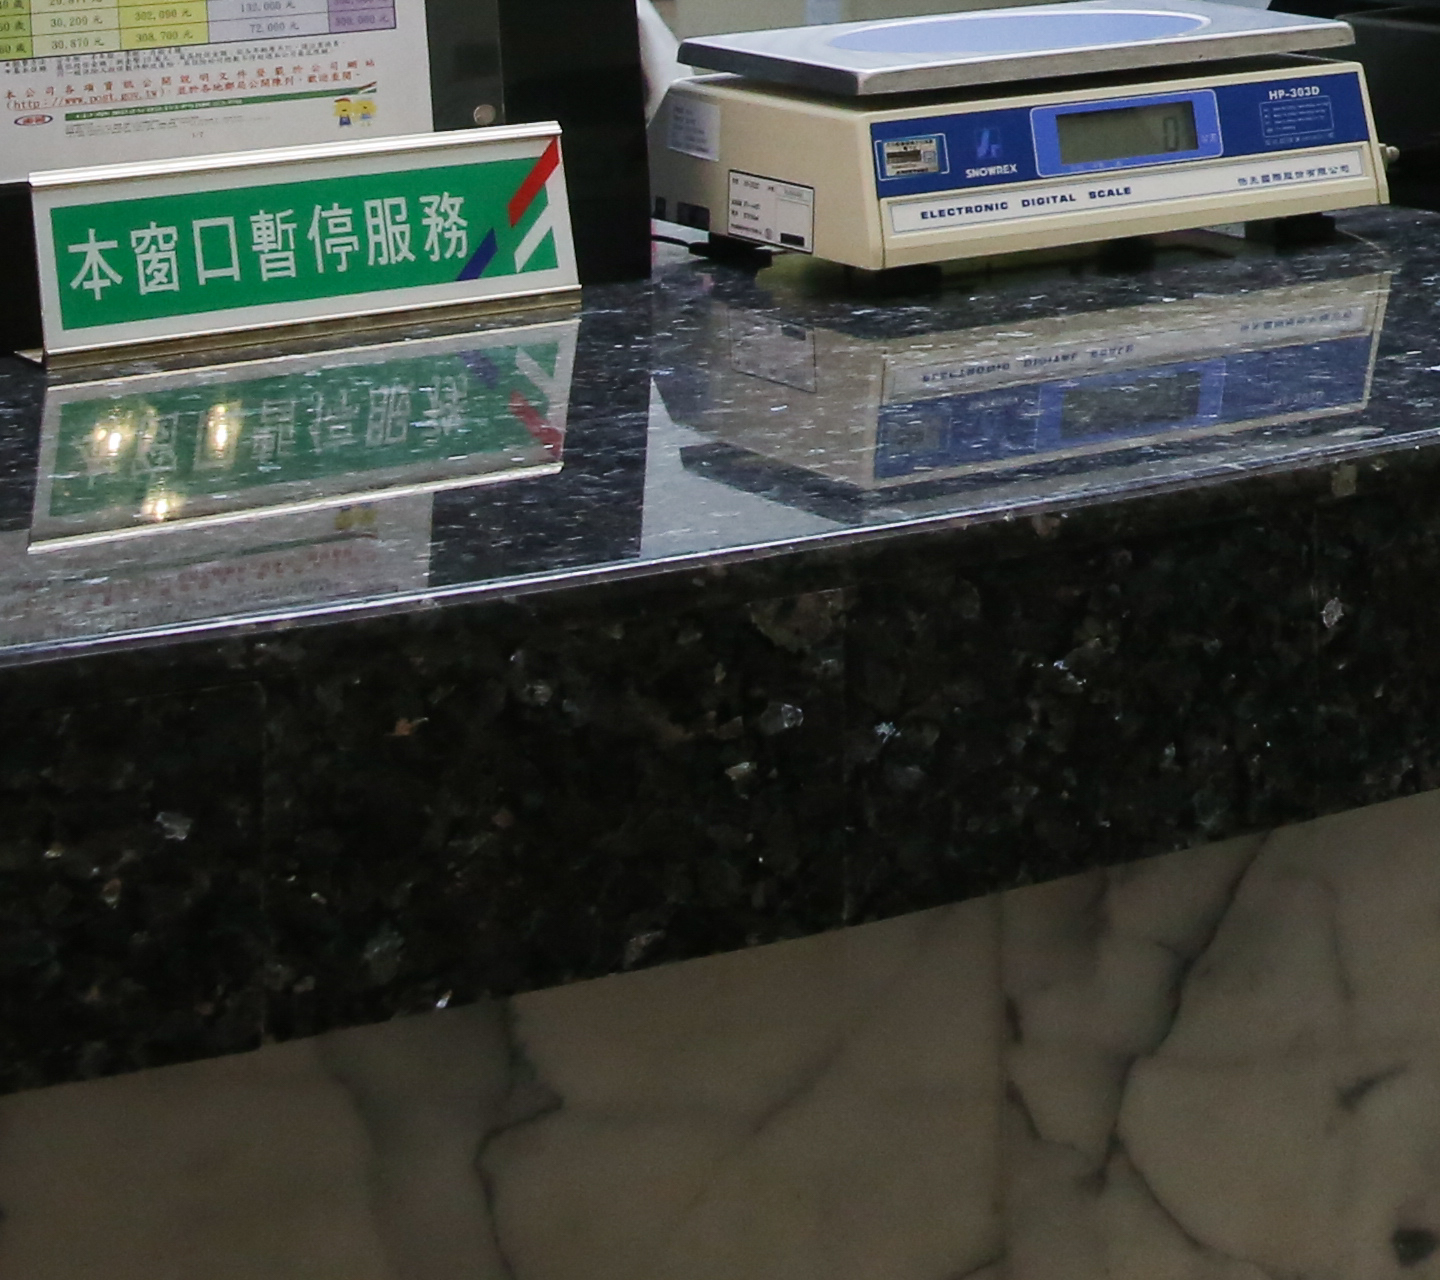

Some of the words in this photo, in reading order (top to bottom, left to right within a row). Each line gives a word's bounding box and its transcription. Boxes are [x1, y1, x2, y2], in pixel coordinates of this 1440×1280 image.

[1268, 85, 1321, 102] HP-303D
[965, 163, 1018, 180] SNOWREX
[920, 200, 1010, 221] ELECTRONIC
[1020, 192, 1077, 209] DIGITAL
[1088, 185, 1133, 200] SCALE
[67, 191, 470, 301] 本窗口暫停服務
